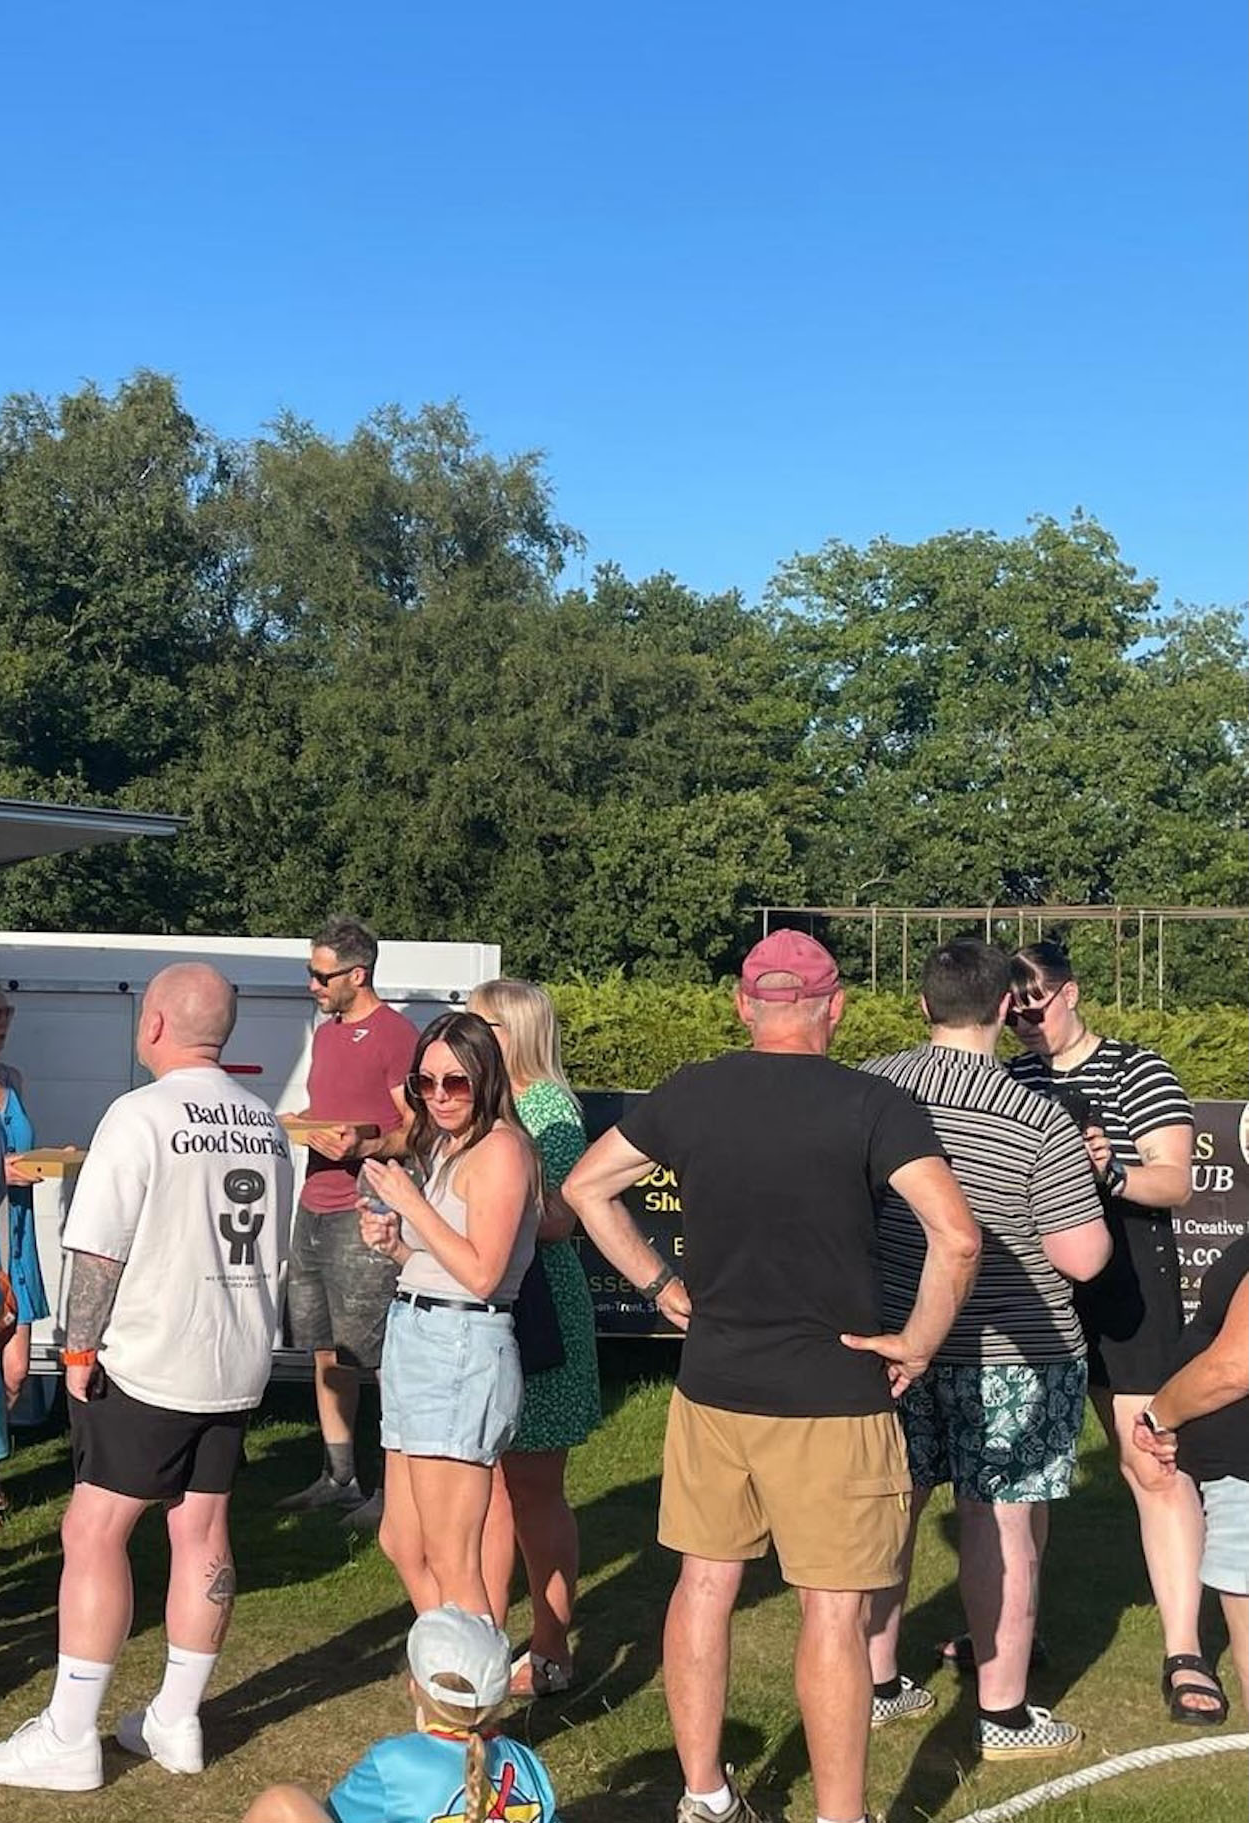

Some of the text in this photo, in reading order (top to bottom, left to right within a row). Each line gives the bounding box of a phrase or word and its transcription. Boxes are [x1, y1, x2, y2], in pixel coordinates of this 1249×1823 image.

[183, 1102, 275, 1128] Bad Ideas
[171, 1130, 228, 1154] Good
[1184, 1219, 1244, 1235] Creative
